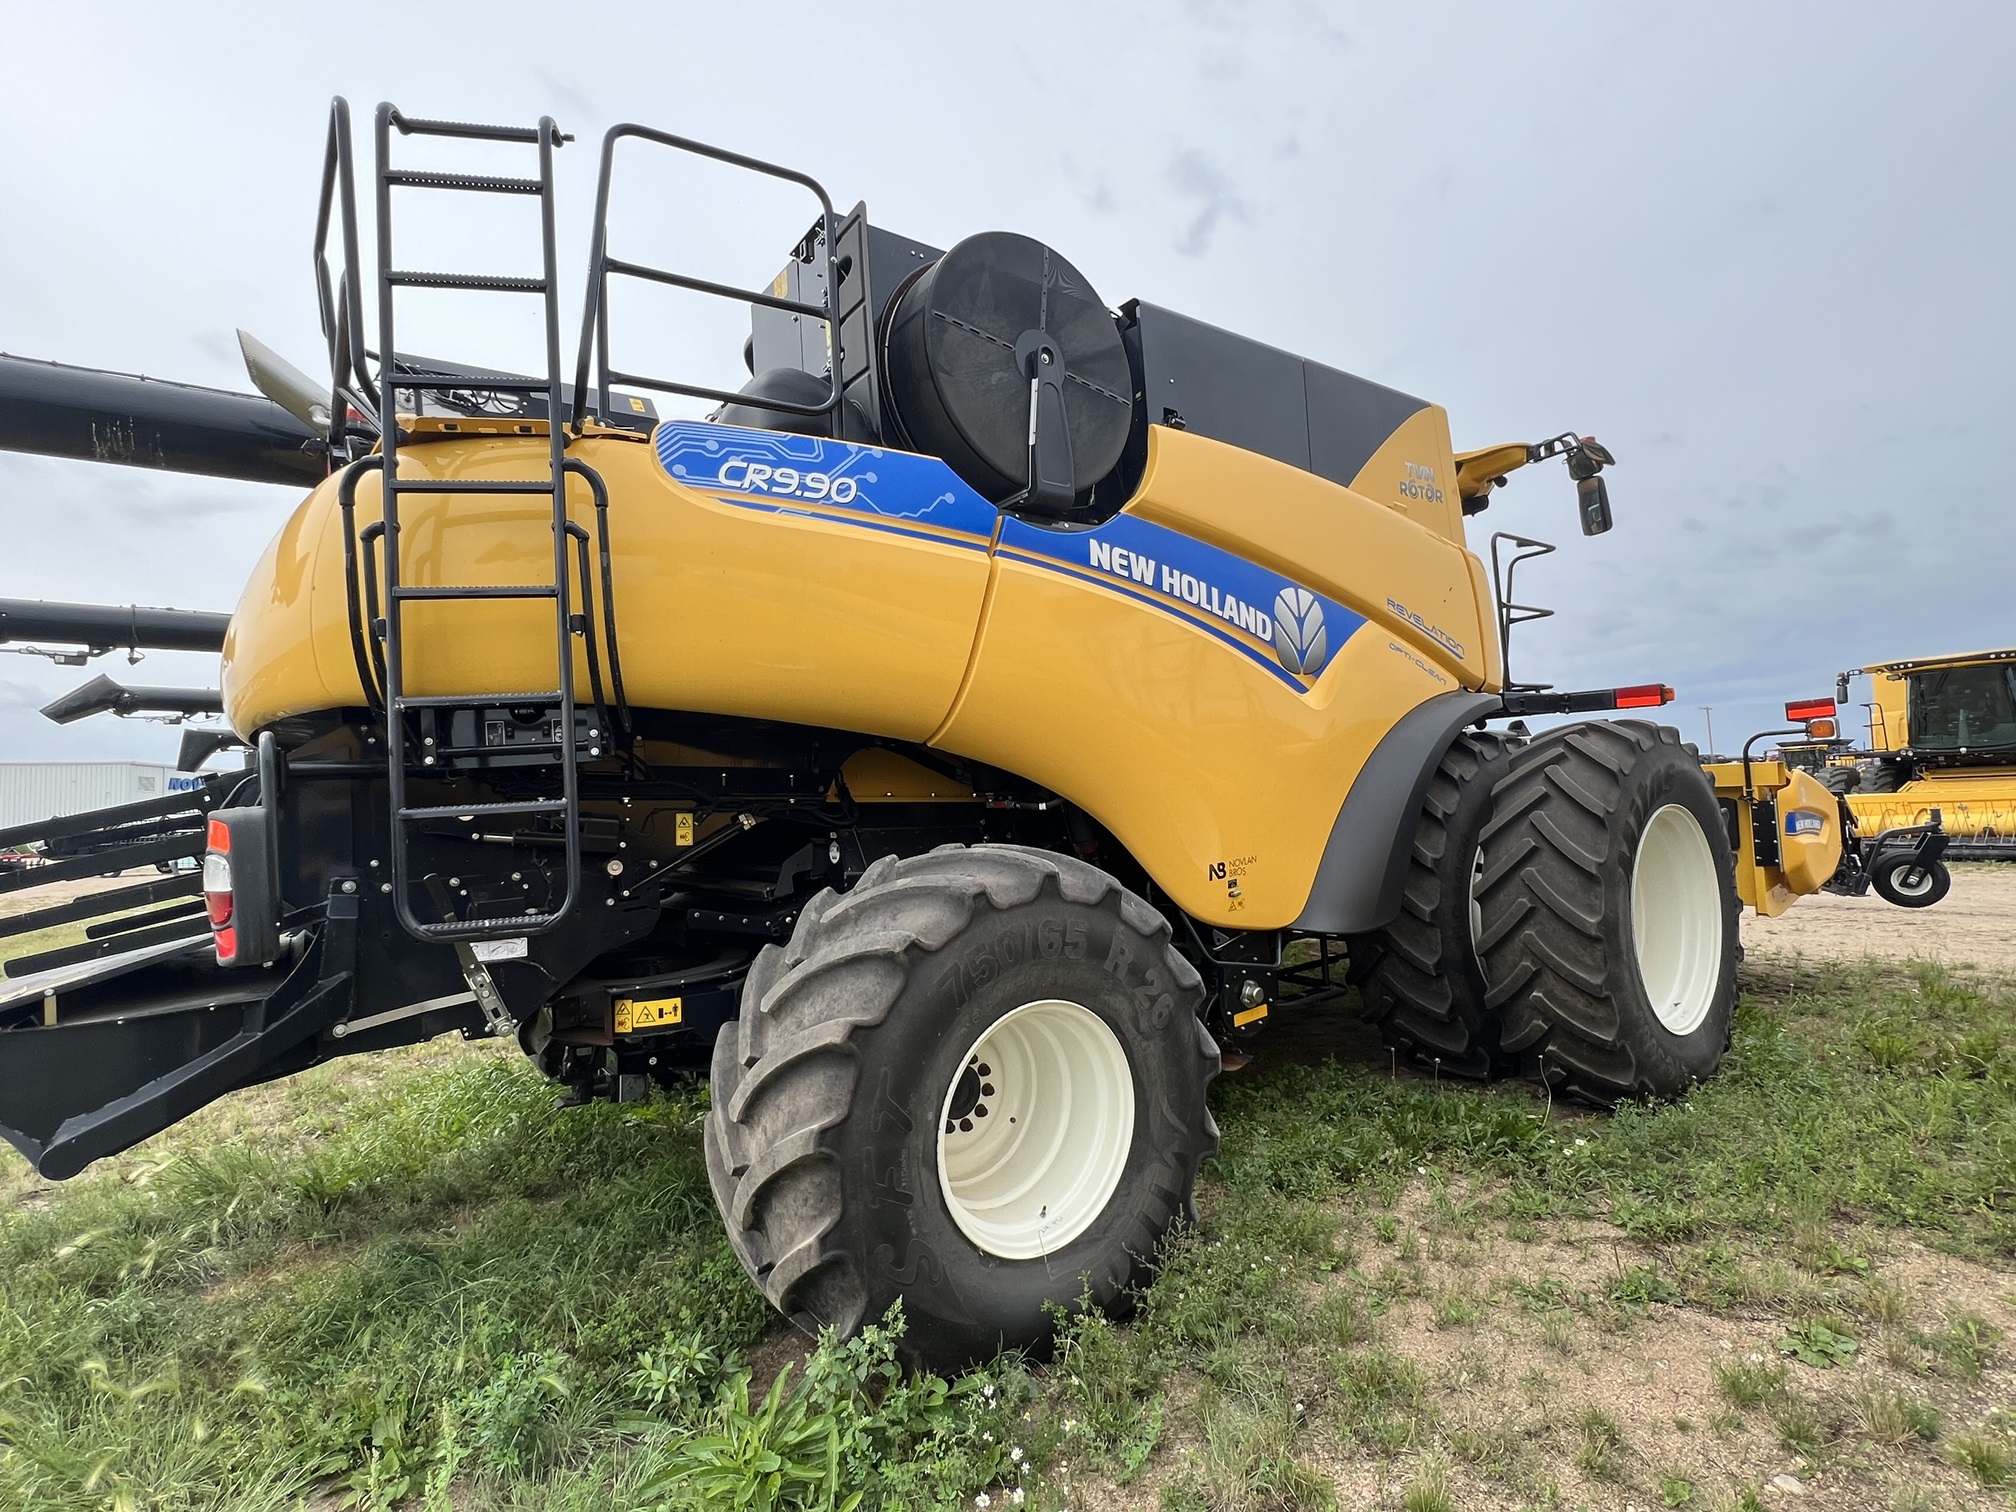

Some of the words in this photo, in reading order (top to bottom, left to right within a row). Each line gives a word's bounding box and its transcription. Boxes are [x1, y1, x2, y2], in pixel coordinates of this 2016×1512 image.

[718, 461, 857, 504] CR9.90
[1399, 478, 1443, 504] ROTOR
[1089, 538, 1156, 586] NEW
[1162, 564, 1273, 642] HOLLAND
[1386, 597, 1465, 656] REVELATION
[1389, 643, 1447, 686] OPTI-CLEAN
[1228, 855, 1257, 868] NOVLAN
[1228, 867, 1247, 877] BROS
[1104, 931, 1134, 980] R
